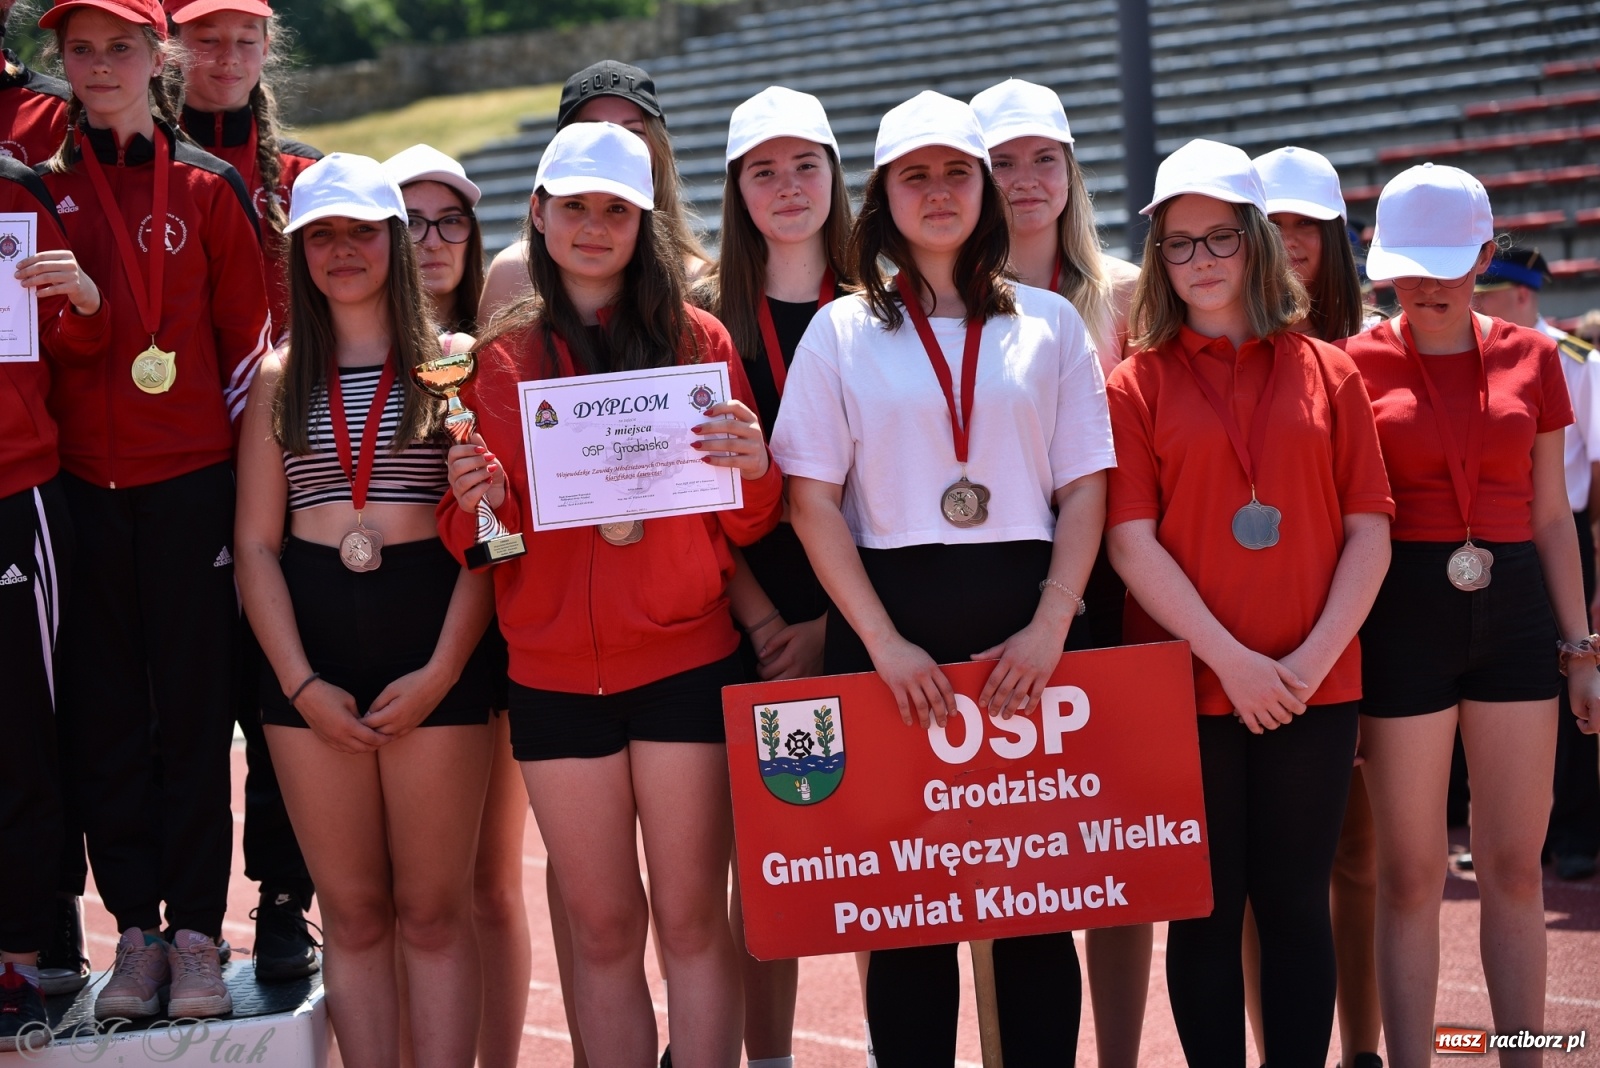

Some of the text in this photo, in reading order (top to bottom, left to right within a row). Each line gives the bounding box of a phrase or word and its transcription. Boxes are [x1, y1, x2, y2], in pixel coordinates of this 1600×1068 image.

[581, 72, 635, 94] EQPT
[573, 393, 669, 419] DYPLOM
[605, 424, 652, 437] 3 miejsca
[582, 436, 669, 461] OSP Grodzisko
[655, 460, 675, 468] Drużyn
[0, 575, 28, 586] adidas
[927, 685, 1091, 764] OSP
[924, 768, 1101, 812] Grodzisko
[762, 814, 1201, 886] Gmina Wręczyca Wielka
[834, 875, 1128, 934] Powiat Kłobuck
